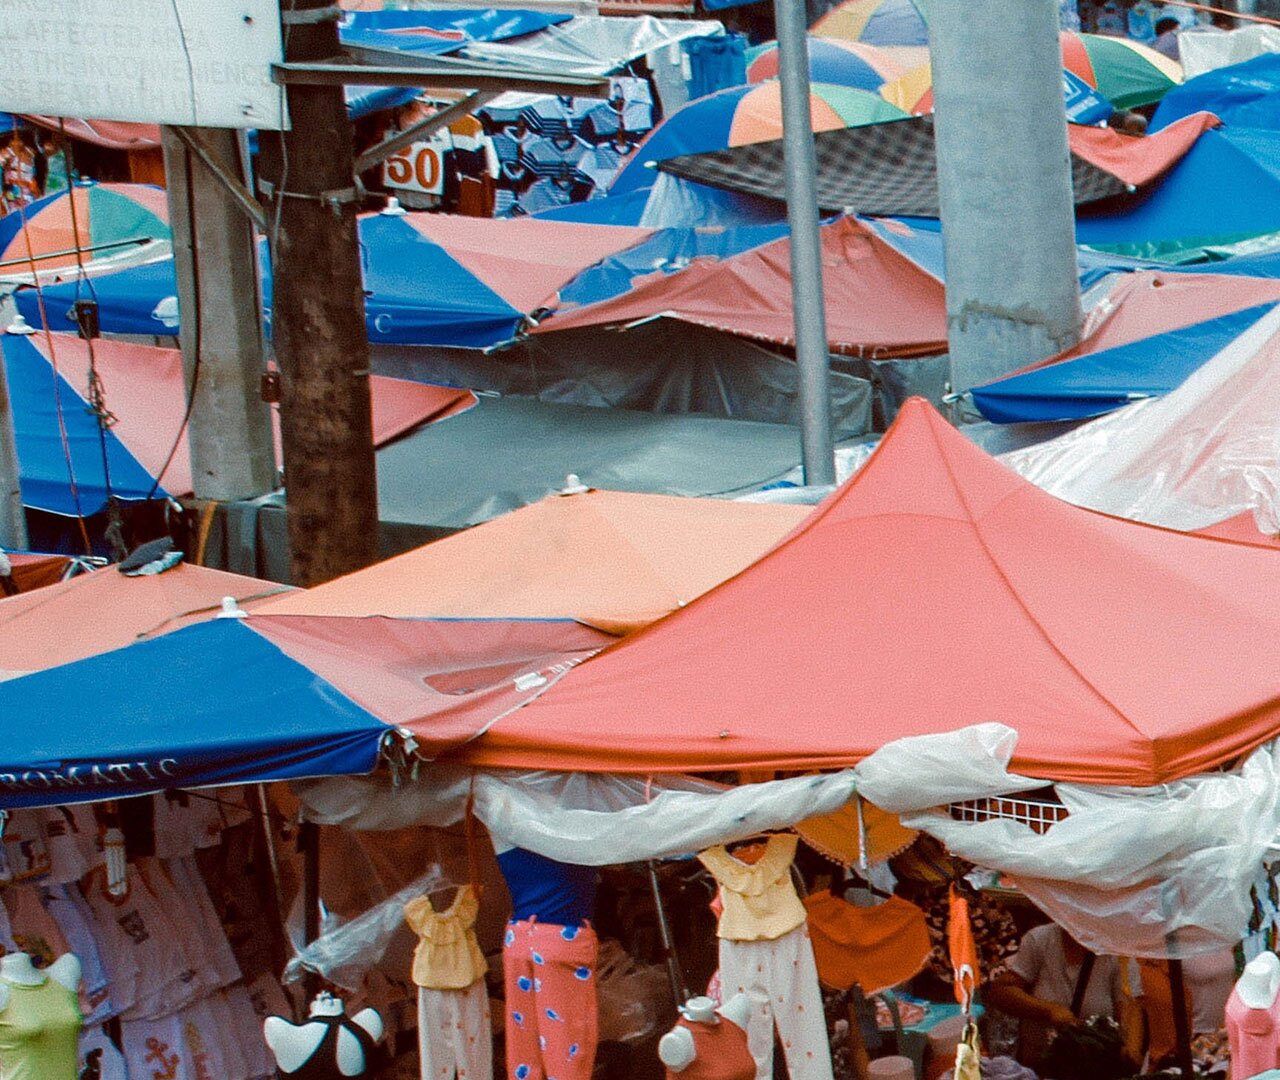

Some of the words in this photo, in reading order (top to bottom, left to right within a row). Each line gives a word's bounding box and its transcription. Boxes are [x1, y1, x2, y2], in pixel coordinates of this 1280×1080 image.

[25, 19, 145, 48] AFFECTED
[29, 50, 76, 77] THE
[387, 145, 440, 189] 50
